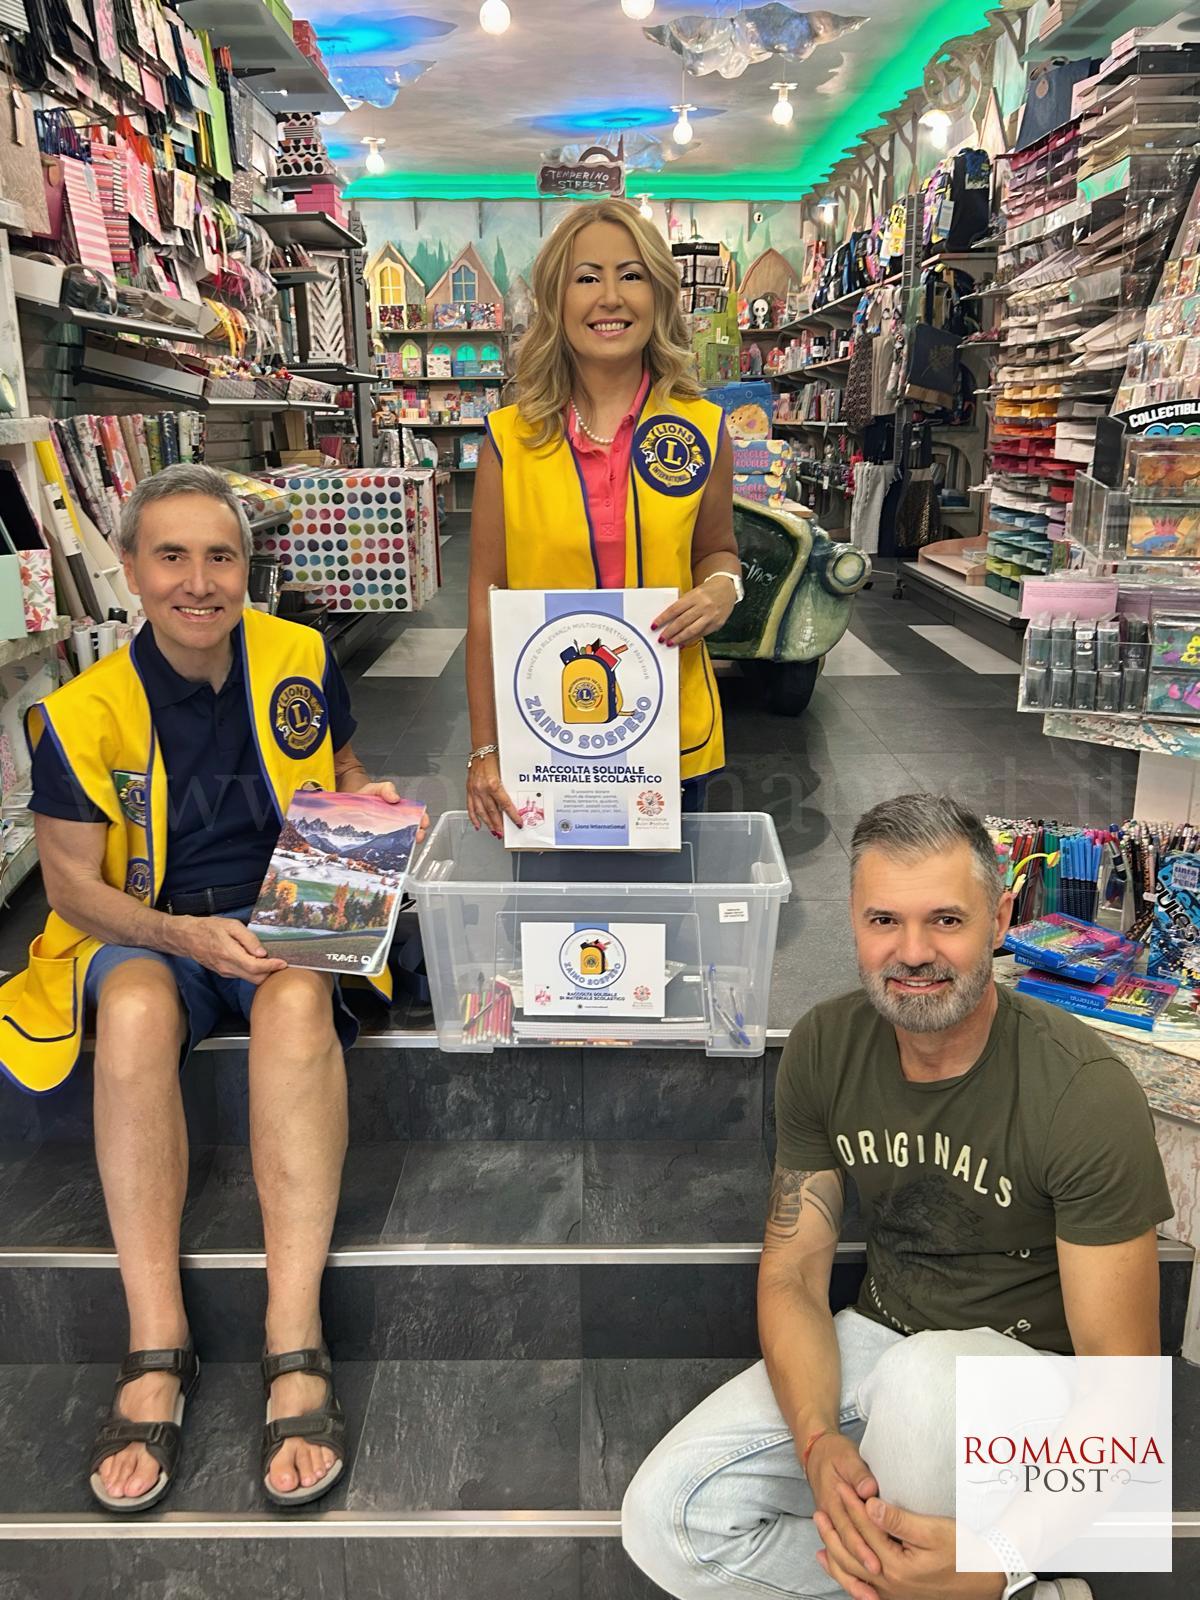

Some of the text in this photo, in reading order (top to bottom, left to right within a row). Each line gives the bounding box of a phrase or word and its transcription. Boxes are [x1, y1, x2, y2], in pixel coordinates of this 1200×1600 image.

[558, 180, 605, 190] STREET
[351, 216, 363, 286] ARTEENE
[1129, 402, 1200, 428] COLLECTIBL
[656, 425, 693, 442] LIONS
[664, 440, 682, 466] L
[280, 686, 309, 702] LIONS
[291, 704, 308, 728] L
[525, 695, 652, 749] ZAINO SOSPESO
[519, 774, 662, 784] DI MATERIALE SCOLASTICO
[535, 765, 645, 775] RACCOLTA SOLIDALE
[325, 953, 359, 963] TRAVEL
[564, 961, 621, 985] ZAINO SOSPESO
[836, 1128, 1013, 1208] ORIGINALS
